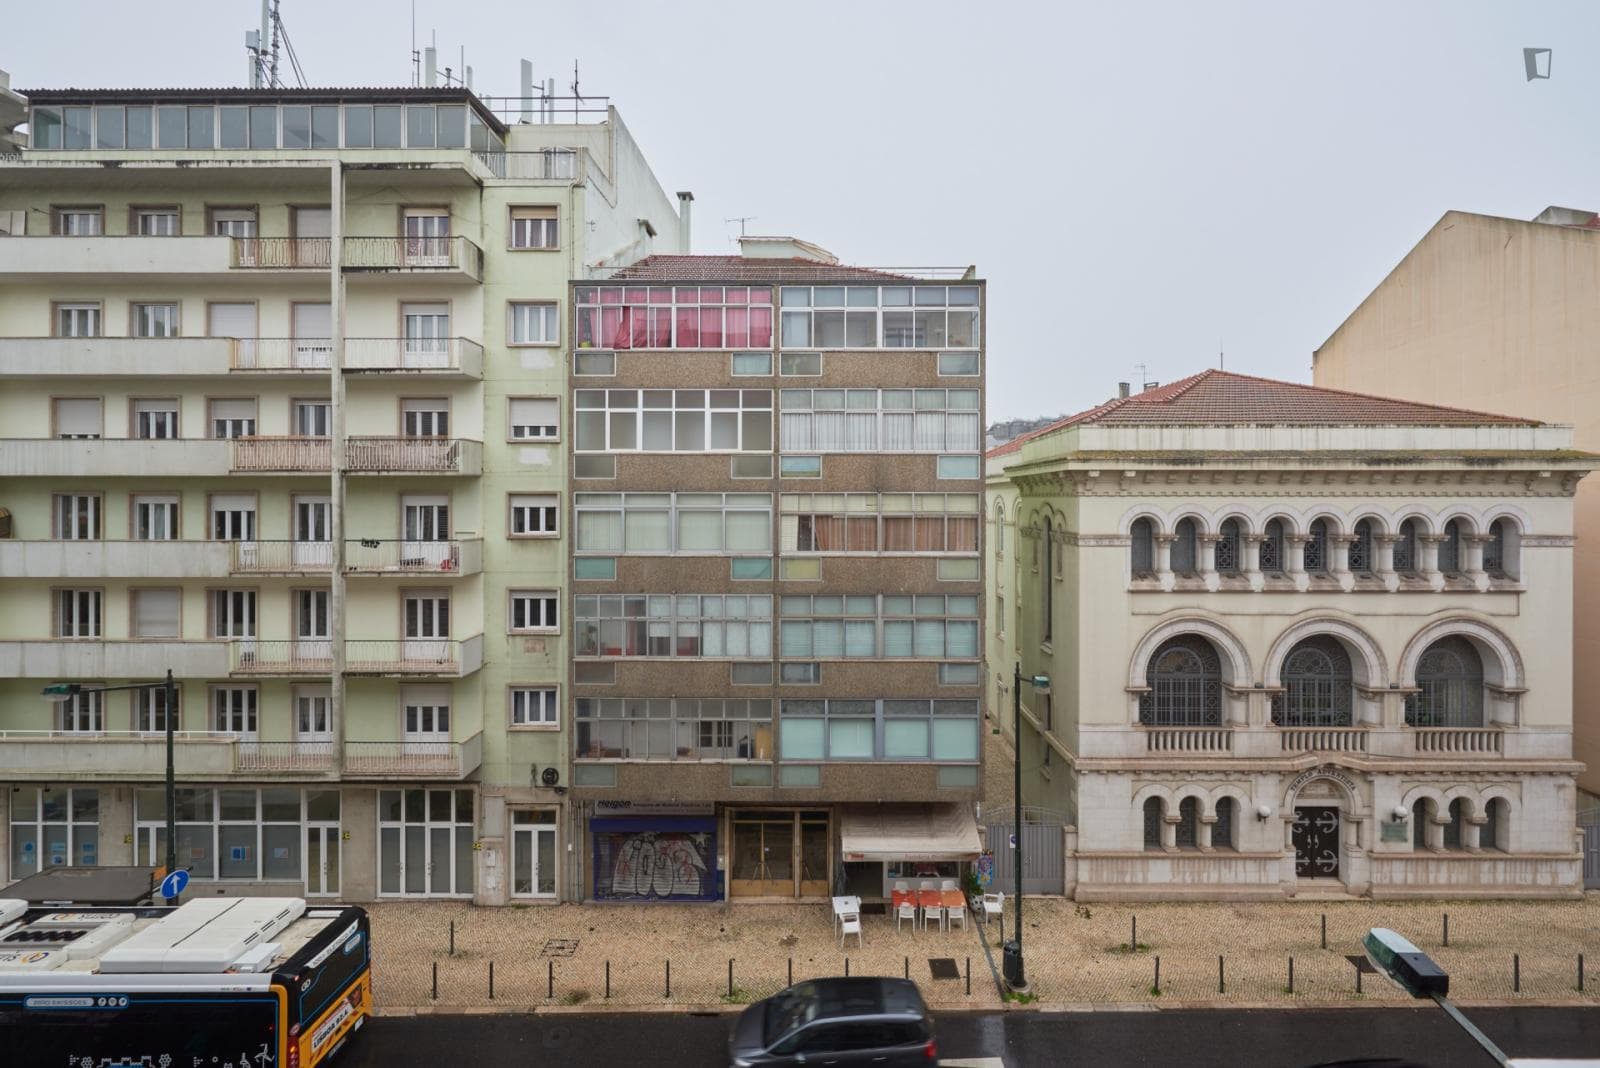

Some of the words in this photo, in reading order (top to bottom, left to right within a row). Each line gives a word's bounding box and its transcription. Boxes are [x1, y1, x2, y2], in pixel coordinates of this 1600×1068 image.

[1290, 771, 1313, 791] TEMPLO
[1317, 767, 1356, 791] ADVENTISTA
[313, 1023, 335, 1048] LISBOA
